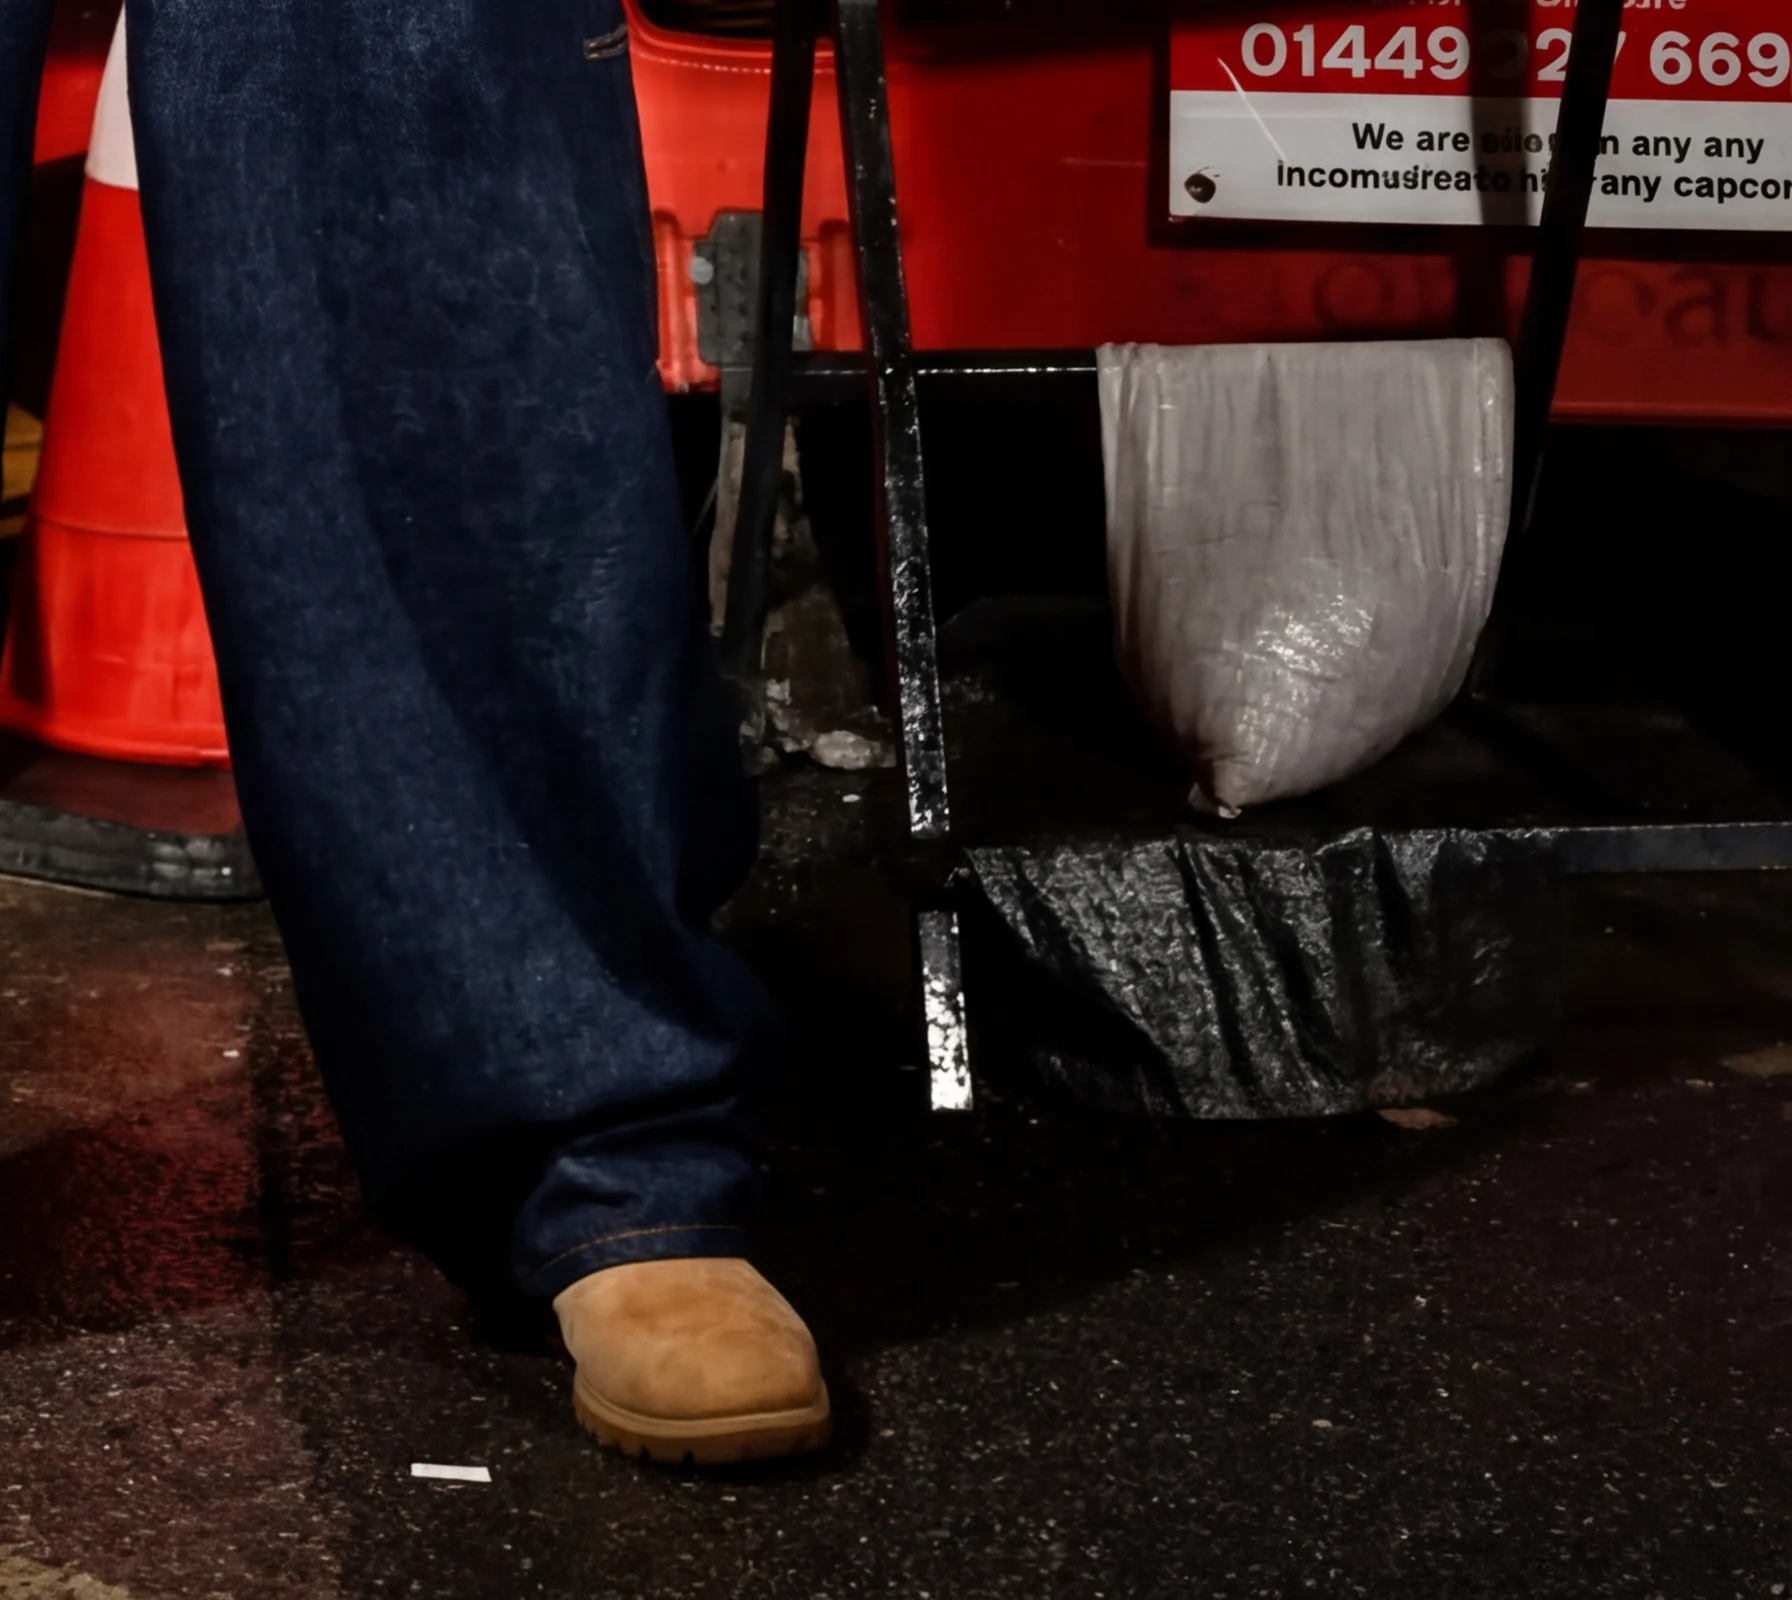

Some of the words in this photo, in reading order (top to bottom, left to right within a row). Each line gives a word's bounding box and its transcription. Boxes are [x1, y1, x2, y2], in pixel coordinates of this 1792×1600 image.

[1241, 22, 1470, 80] 01449
[1352, 122, 1404, 150] We
[1416, 131, 1470, 152] are
[1632, 135, 1692, 163] any
[1704, 136, 1765, 164] any
[1600, 173, 1661, 202] any
